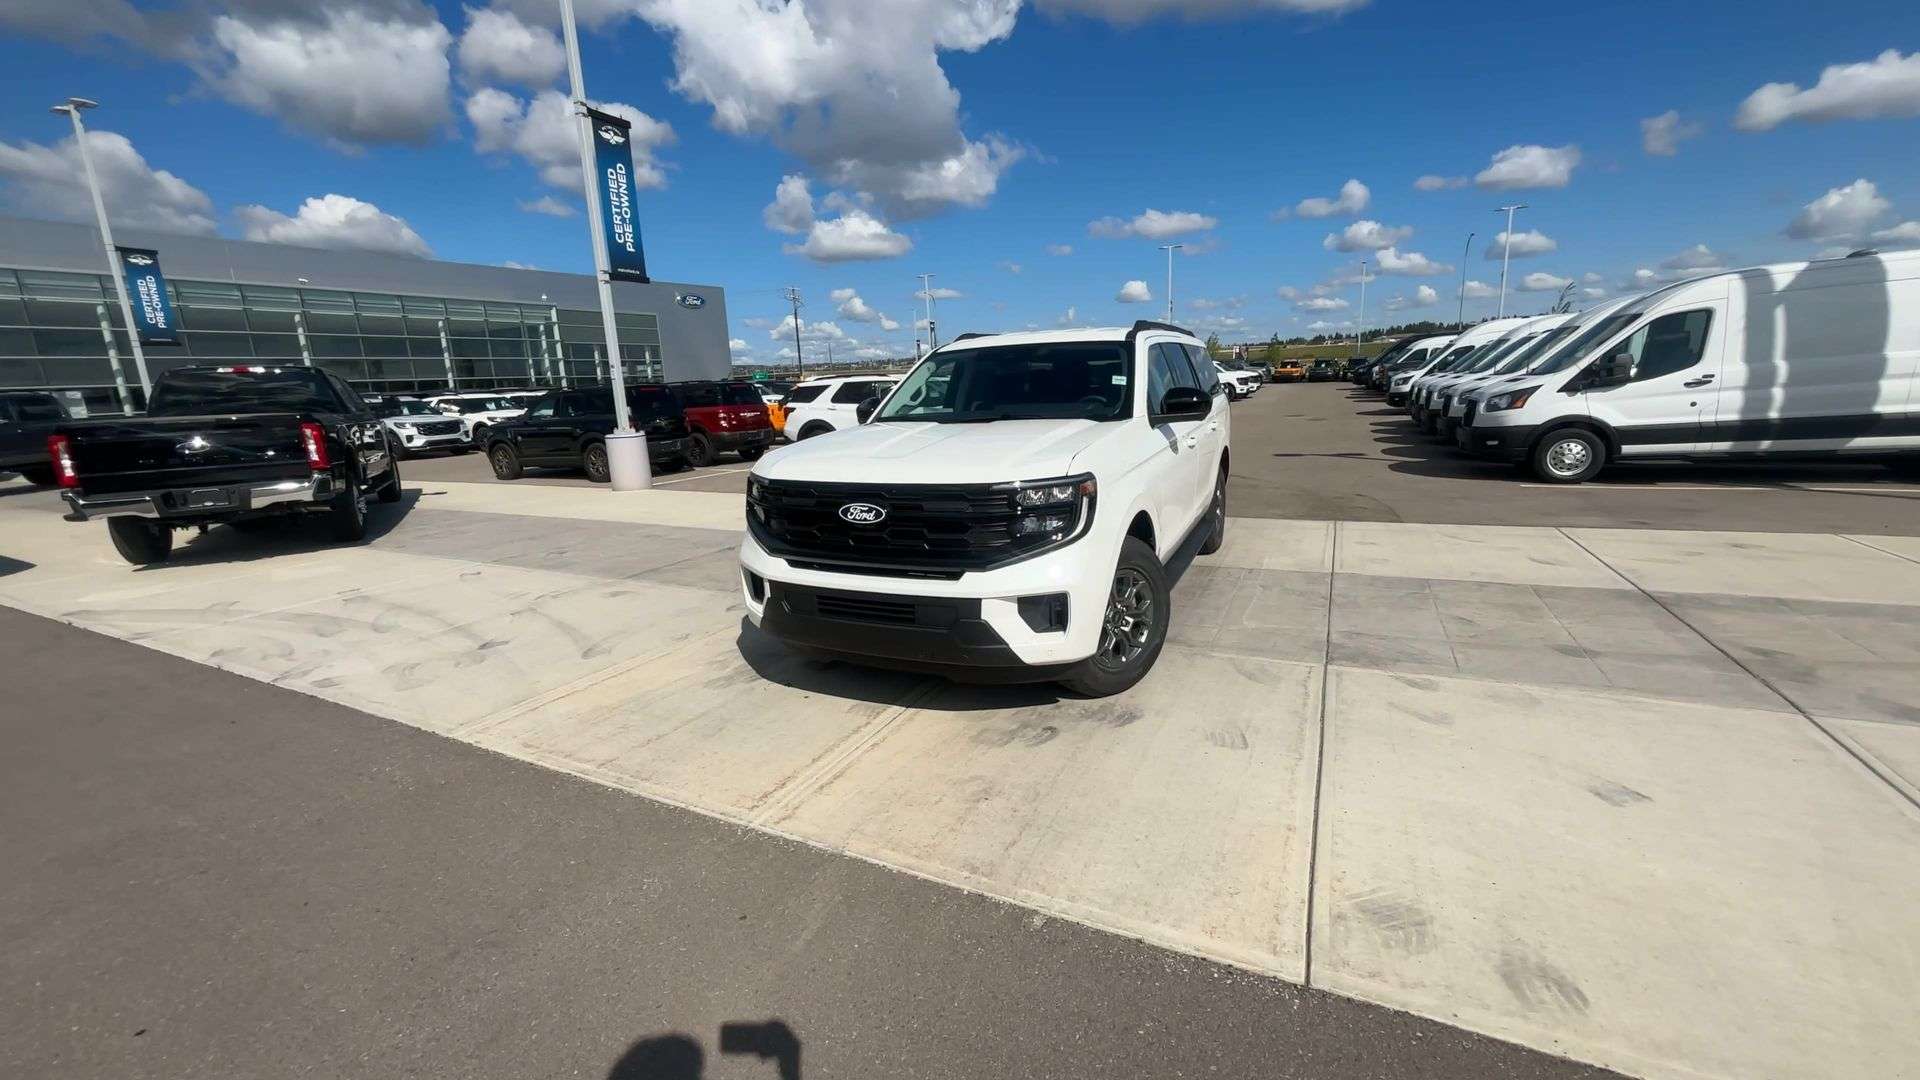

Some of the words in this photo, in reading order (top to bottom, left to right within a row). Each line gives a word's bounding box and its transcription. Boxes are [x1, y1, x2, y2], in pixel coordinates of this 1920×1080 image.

[607, 168, 625, 244] CERTIFIED
[616, 163, 636, 252] PRE-OWNED
[137, 279, 156, 324] CERTIFIED
[146, 275, 167, 329] PRE-OWNED
[847, 505, 876, 520] Ford
